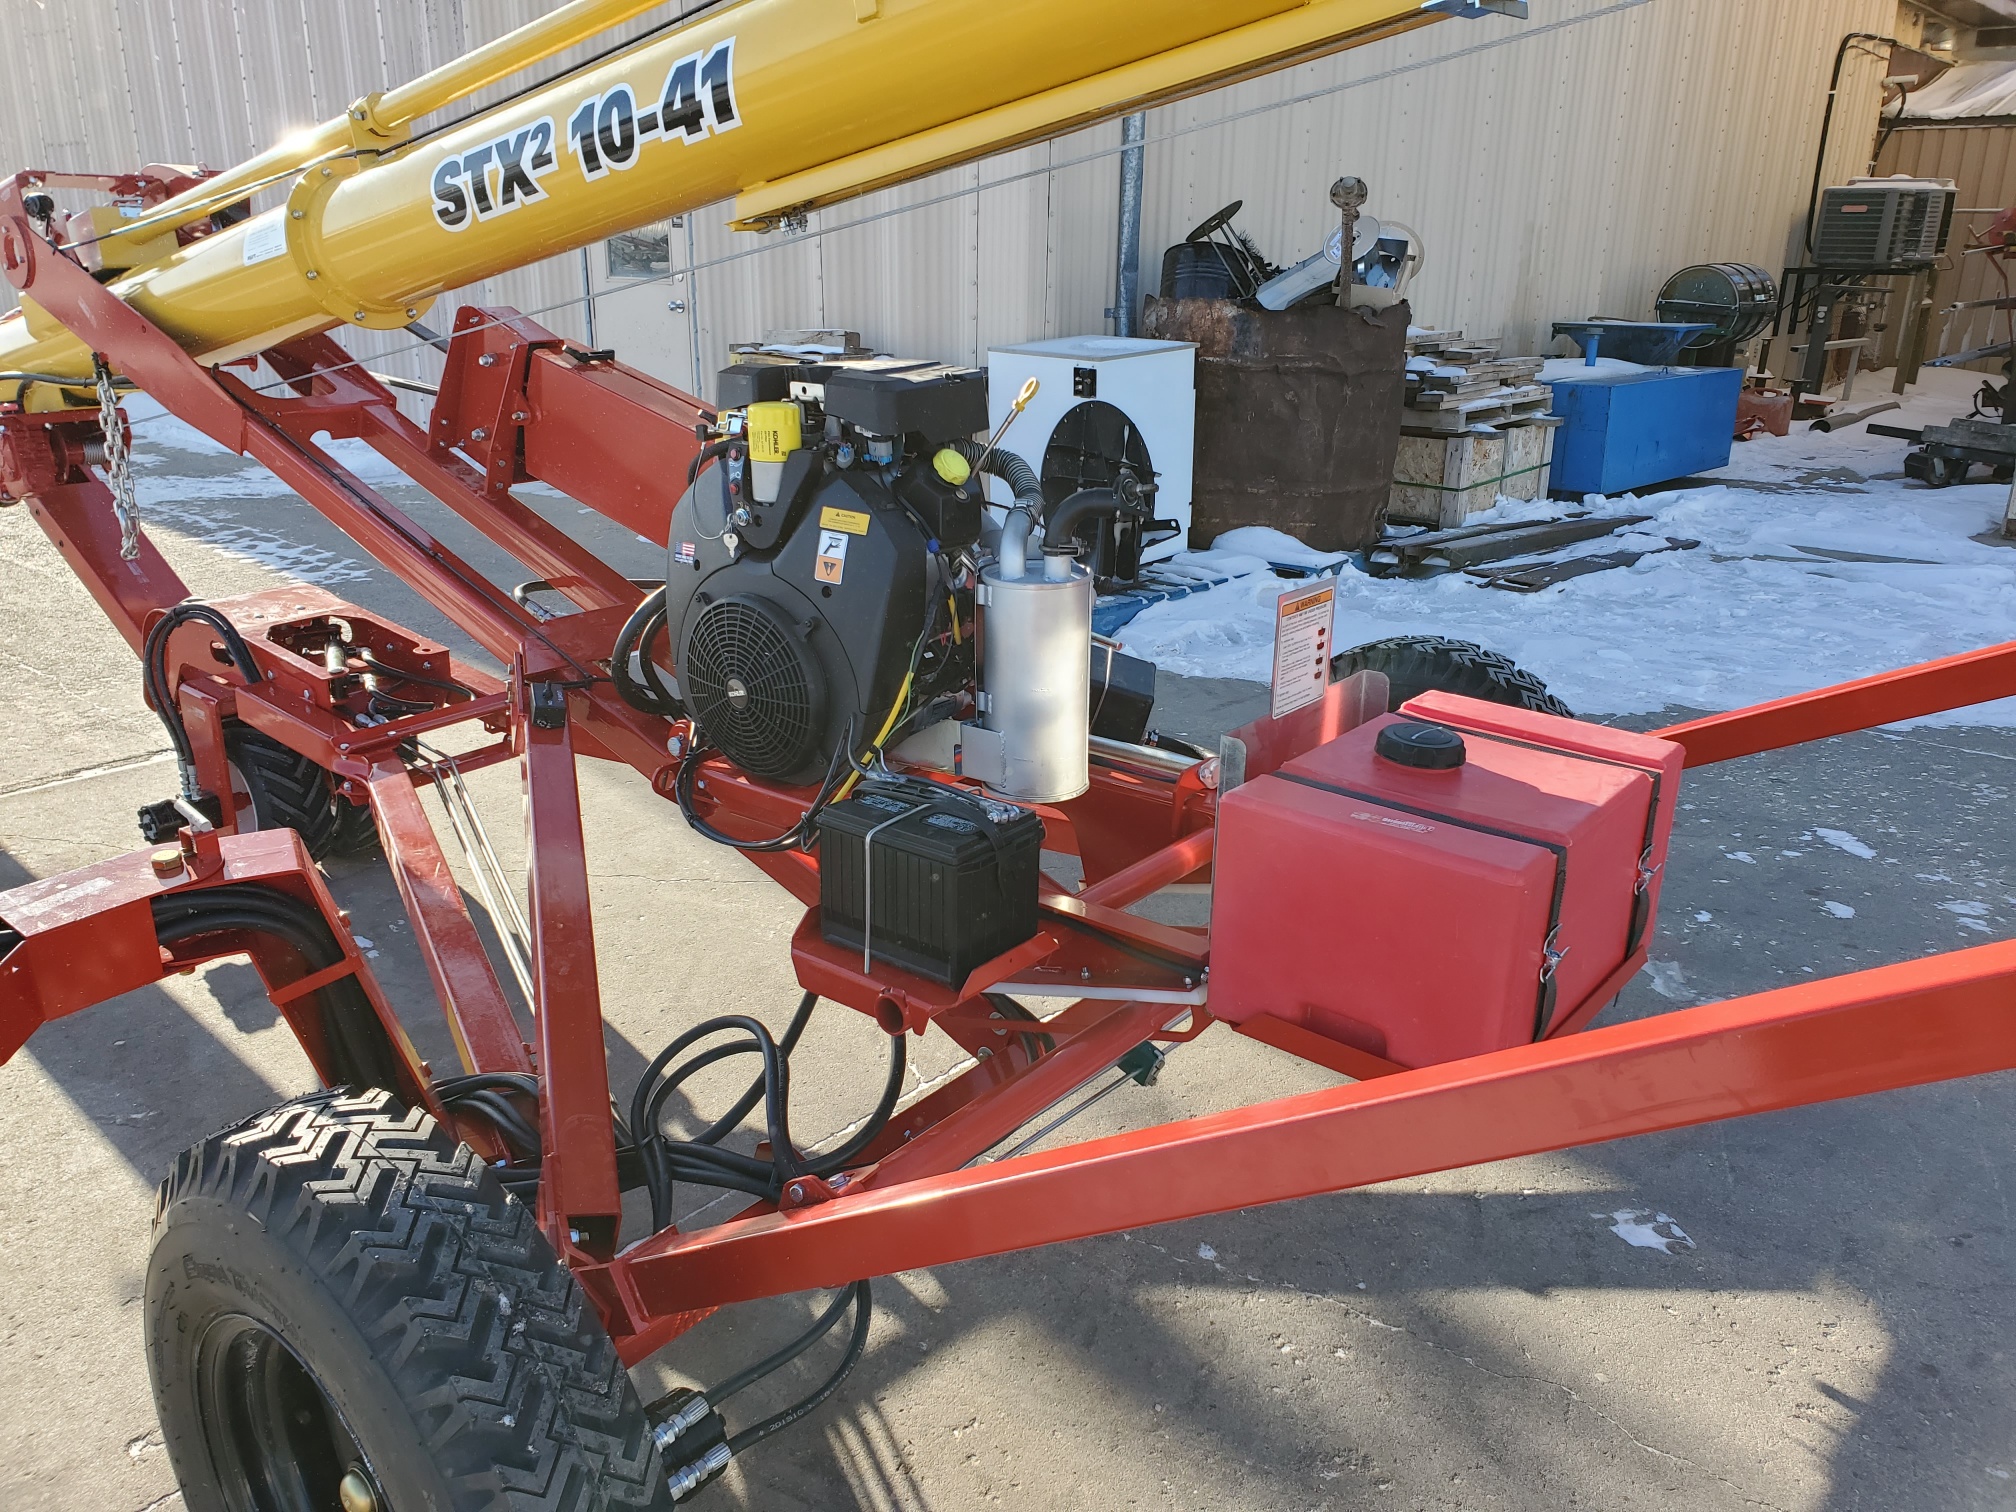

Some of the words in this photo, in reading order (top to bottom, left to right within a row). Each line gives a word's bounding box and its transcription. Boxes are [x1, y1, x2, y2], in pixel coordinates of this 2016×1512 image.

[570, 42, 738, 177] 10-41
[772, 430, 780, 456] KOHLER
[1300, 595, 1321, 608] WARNING
